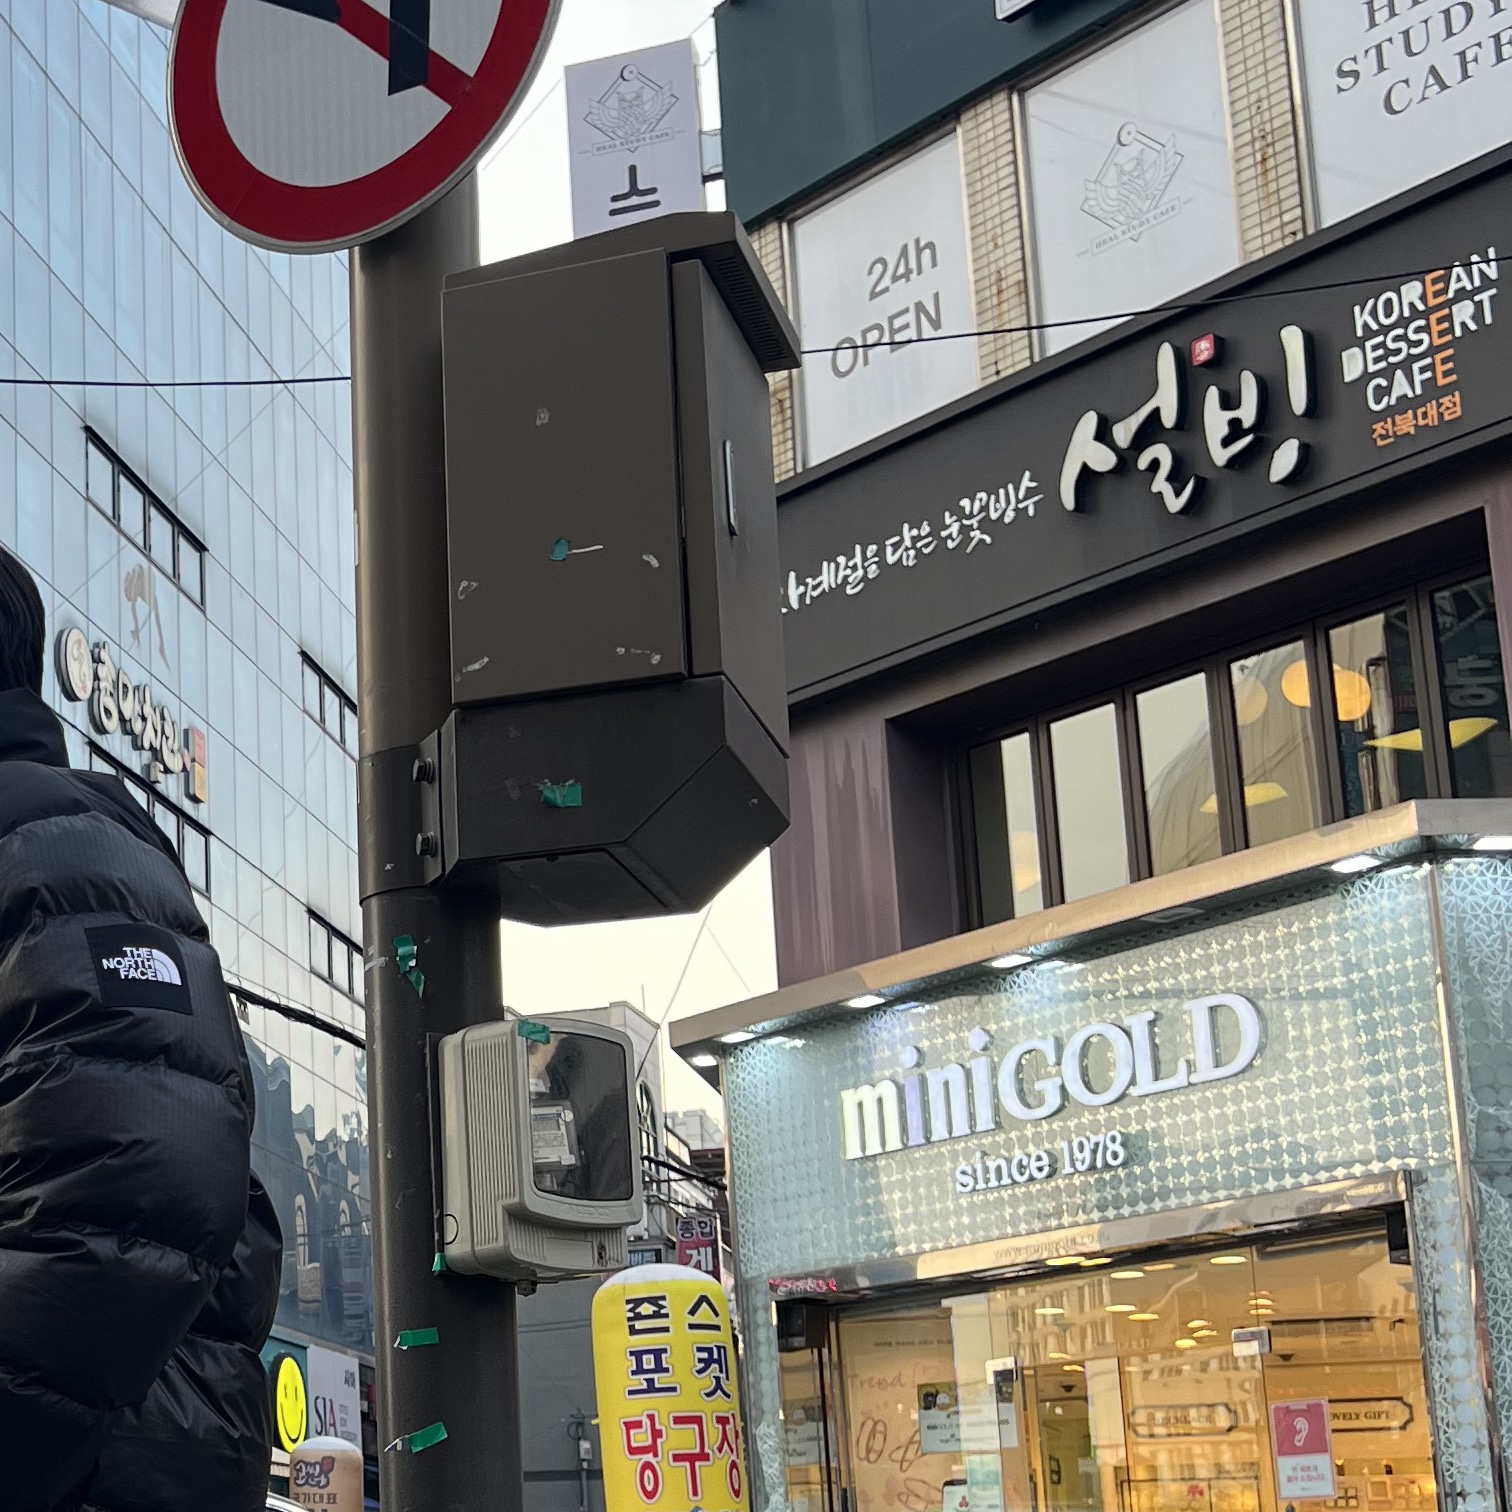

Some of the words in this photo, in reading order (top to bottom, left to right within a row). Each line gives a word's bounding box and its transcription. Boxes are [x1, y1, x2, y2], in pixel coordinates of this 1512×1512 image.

[867, 235, 938, 302] 24h
[1353, 246, 1499, 338] KOREAN
[830, 291, 944, 380] OPEN
[1341, 287, 1498, 383] DESSERT
[1366, 347, 1458, 412] CAFE
[1371, 390, 1463, 448] 전북대점
[101, 957, 155, 970] NORTH
[119, 968, 158, 981] FACE
[122, 946, 153, 959] THE
[955, 1144, 1051, 1195] since
[1061, 1130, 1127, 1175] 1978
[625, 1344, 732, 1400] 포켓
[620, 1412, 742, 1502] 당구장
